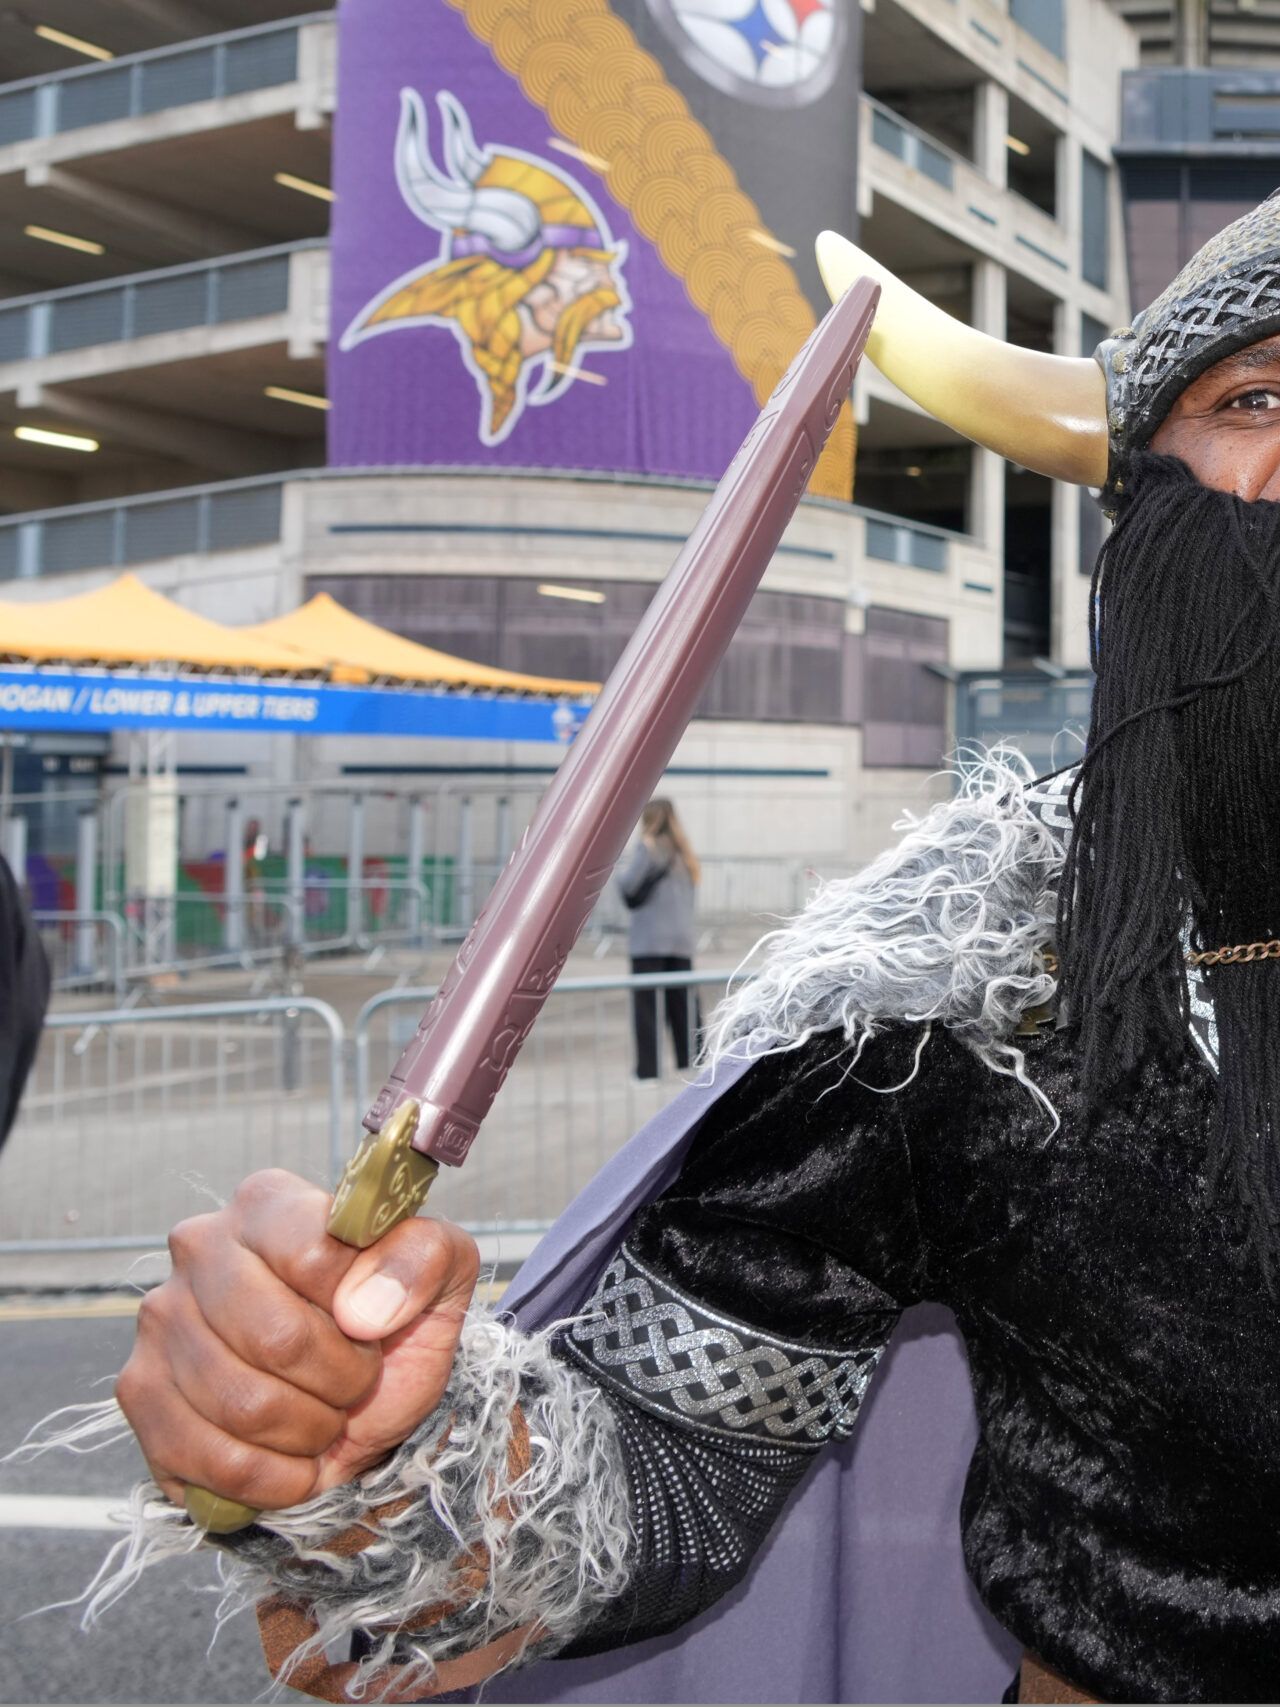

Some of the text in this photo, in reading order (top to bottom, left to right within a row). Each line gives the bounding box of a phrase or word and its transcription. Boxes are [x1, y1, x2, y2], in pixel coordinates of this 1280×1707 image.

[0, 684, 74, 712] OGAN
[89, 687, 173, 716] LOWER
[173, 691, 191, 717] &
[193, 692, 260, 719] UPPER
[261, 695, 318, 722] TIERS
